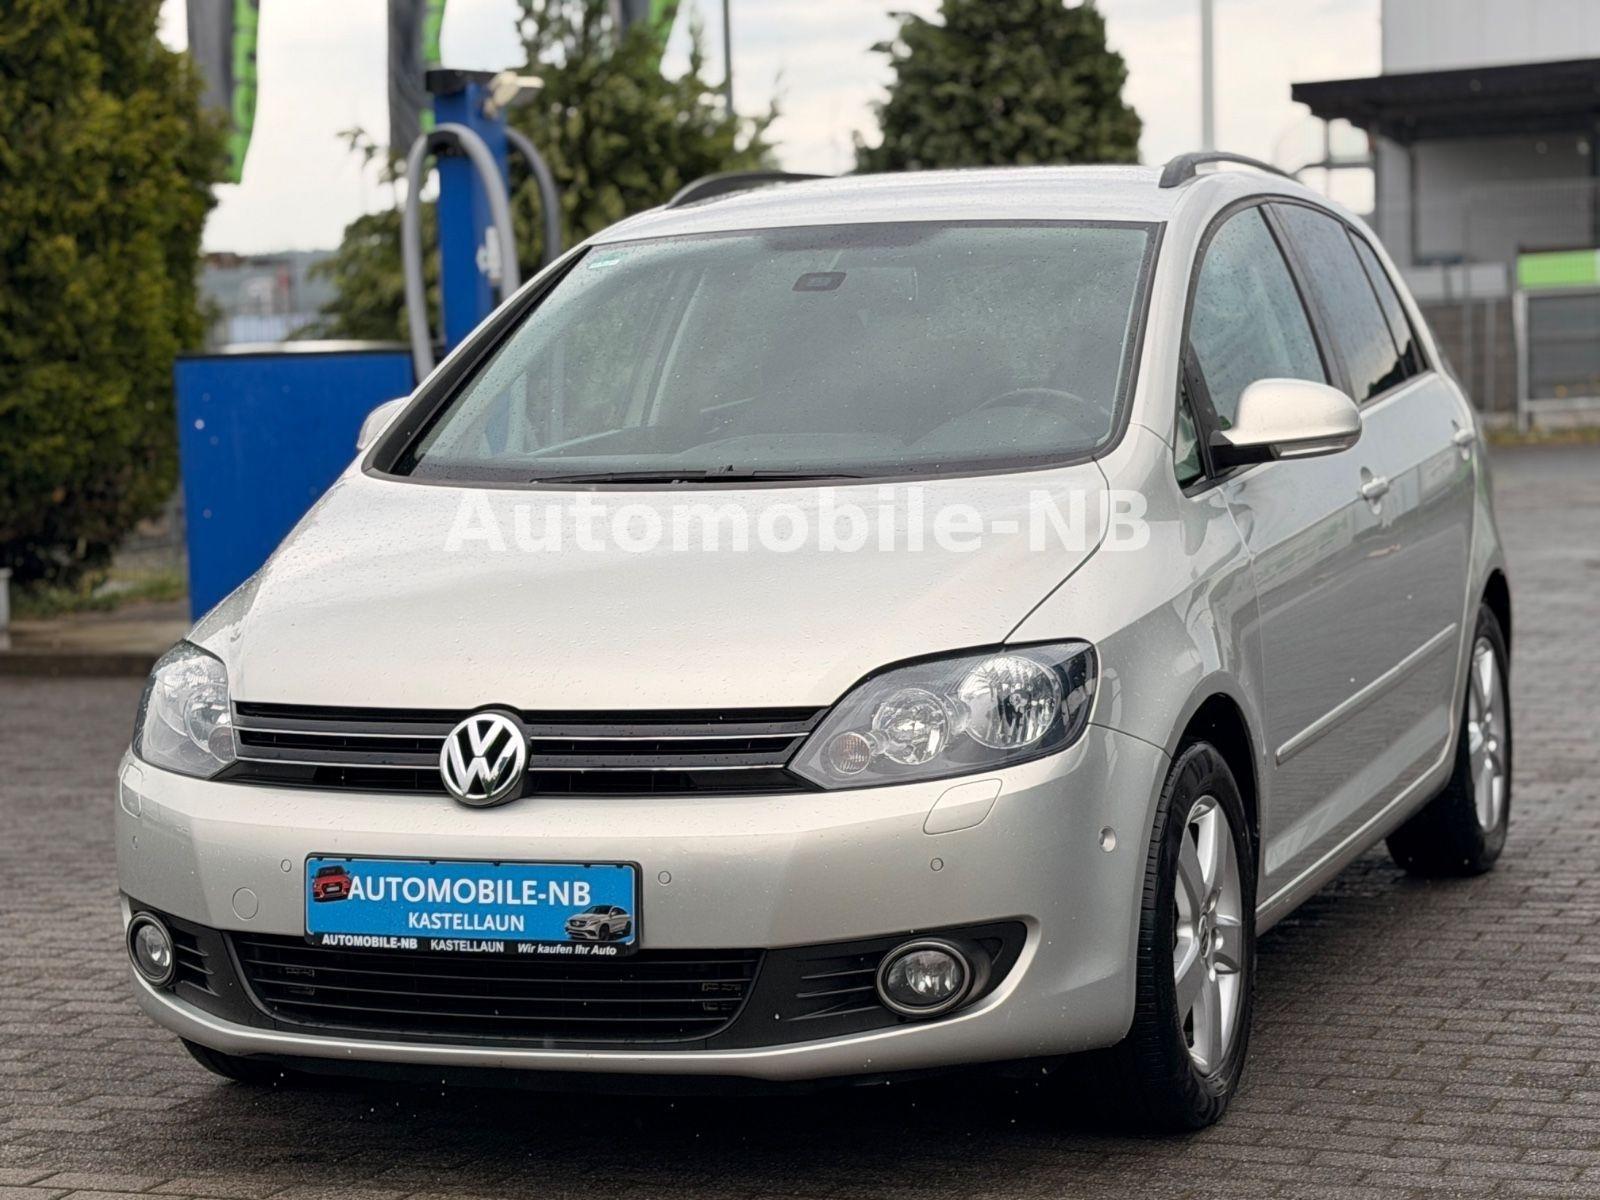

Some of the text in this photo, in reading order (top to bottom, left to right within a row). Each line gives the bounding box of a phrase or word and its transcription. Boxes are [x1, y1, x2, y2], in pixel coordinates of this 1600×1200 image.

[443, 713, 523, 799] VW
[348, 875, 591, 906] AUTOMOBILE-NB
[408, 912, 524, 932] KASTELLAUN
[321, 934, 617, 956] AUTOMOBILE-NB KASTELLAUN Wir kaufen Ihr Auto
